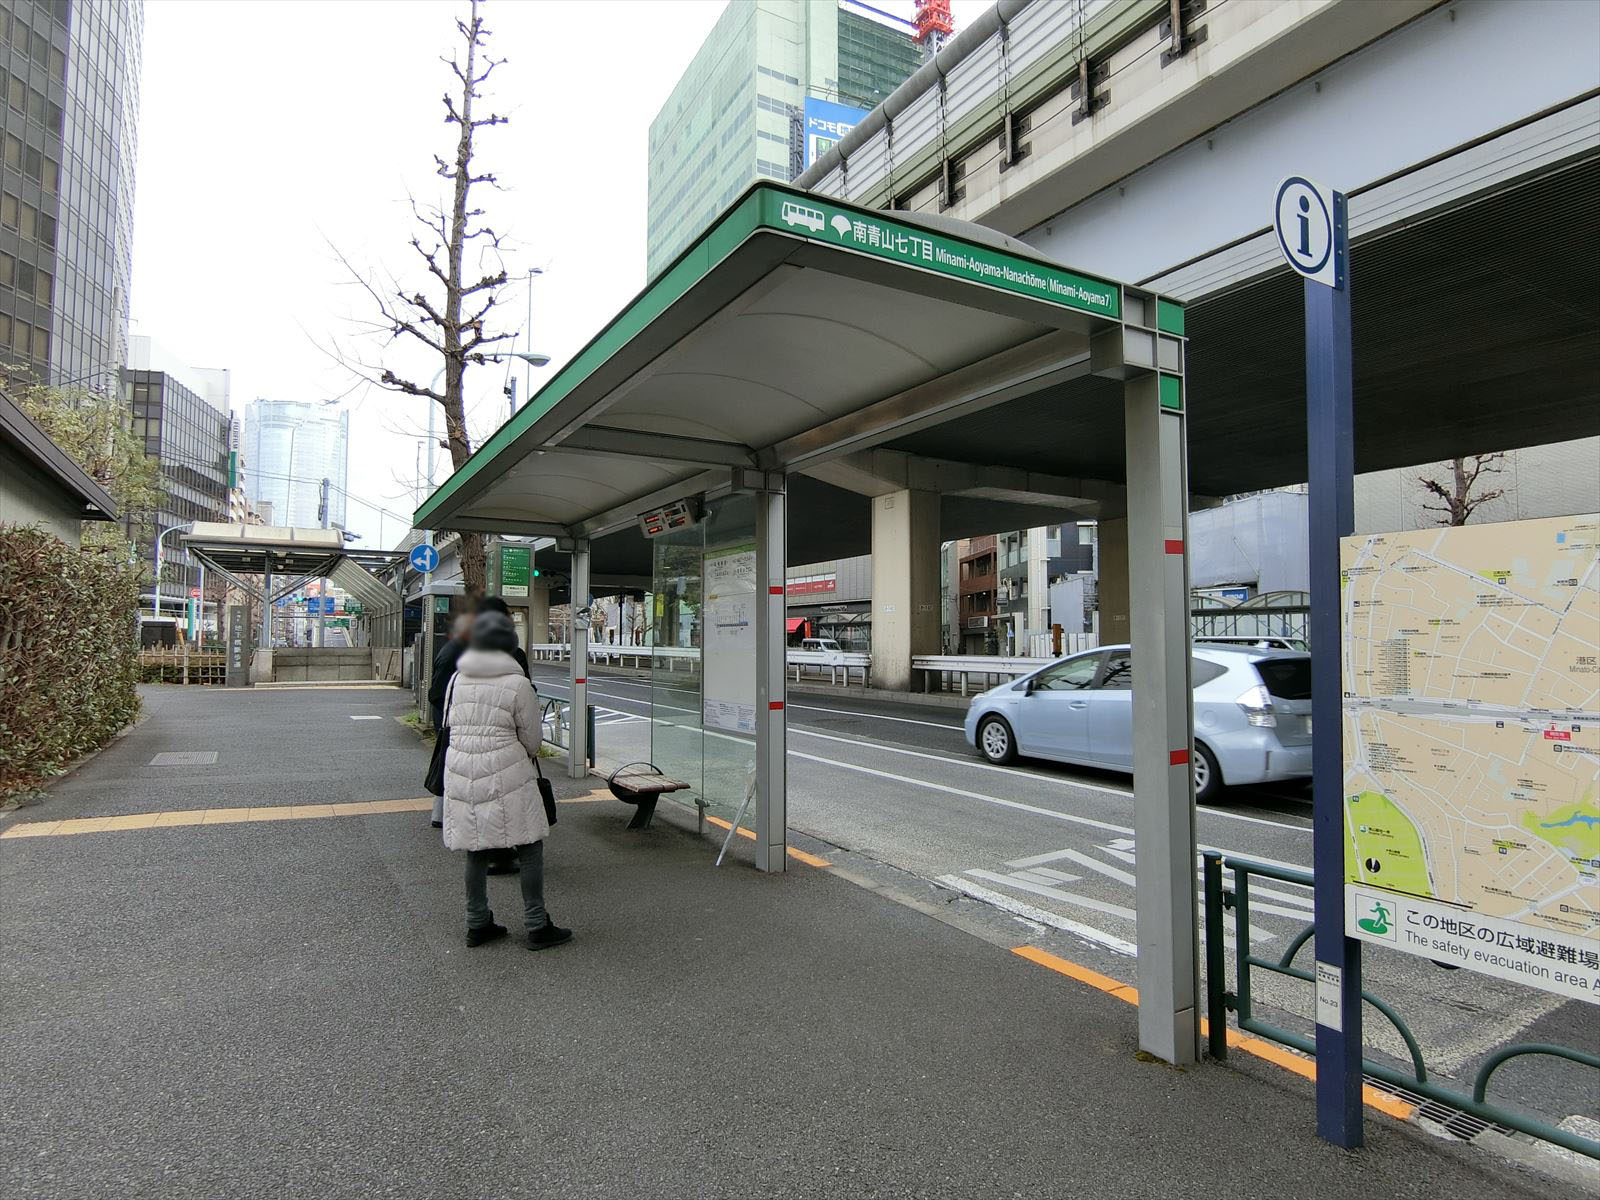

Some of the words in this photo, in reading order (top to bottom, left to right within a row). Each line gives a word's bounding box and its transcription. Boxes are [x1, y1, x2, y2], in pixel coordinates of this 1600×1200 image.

[853, 220, 933, 262] 南青山七丁目
[935, 247, 1047, 290] Minami-Aoyama-Nanachōme
[1046, 277, 1112, 310] (Minami-Aoyama7)
[1405, 929, 1428, 947] The
[1432, 936, 1470, 960] safety
[1474, 951, 1550, 979] evacuation
[1554, 970, 1588, 989] area
[1406, 909, 1600, 971] この地区の広域避難場
